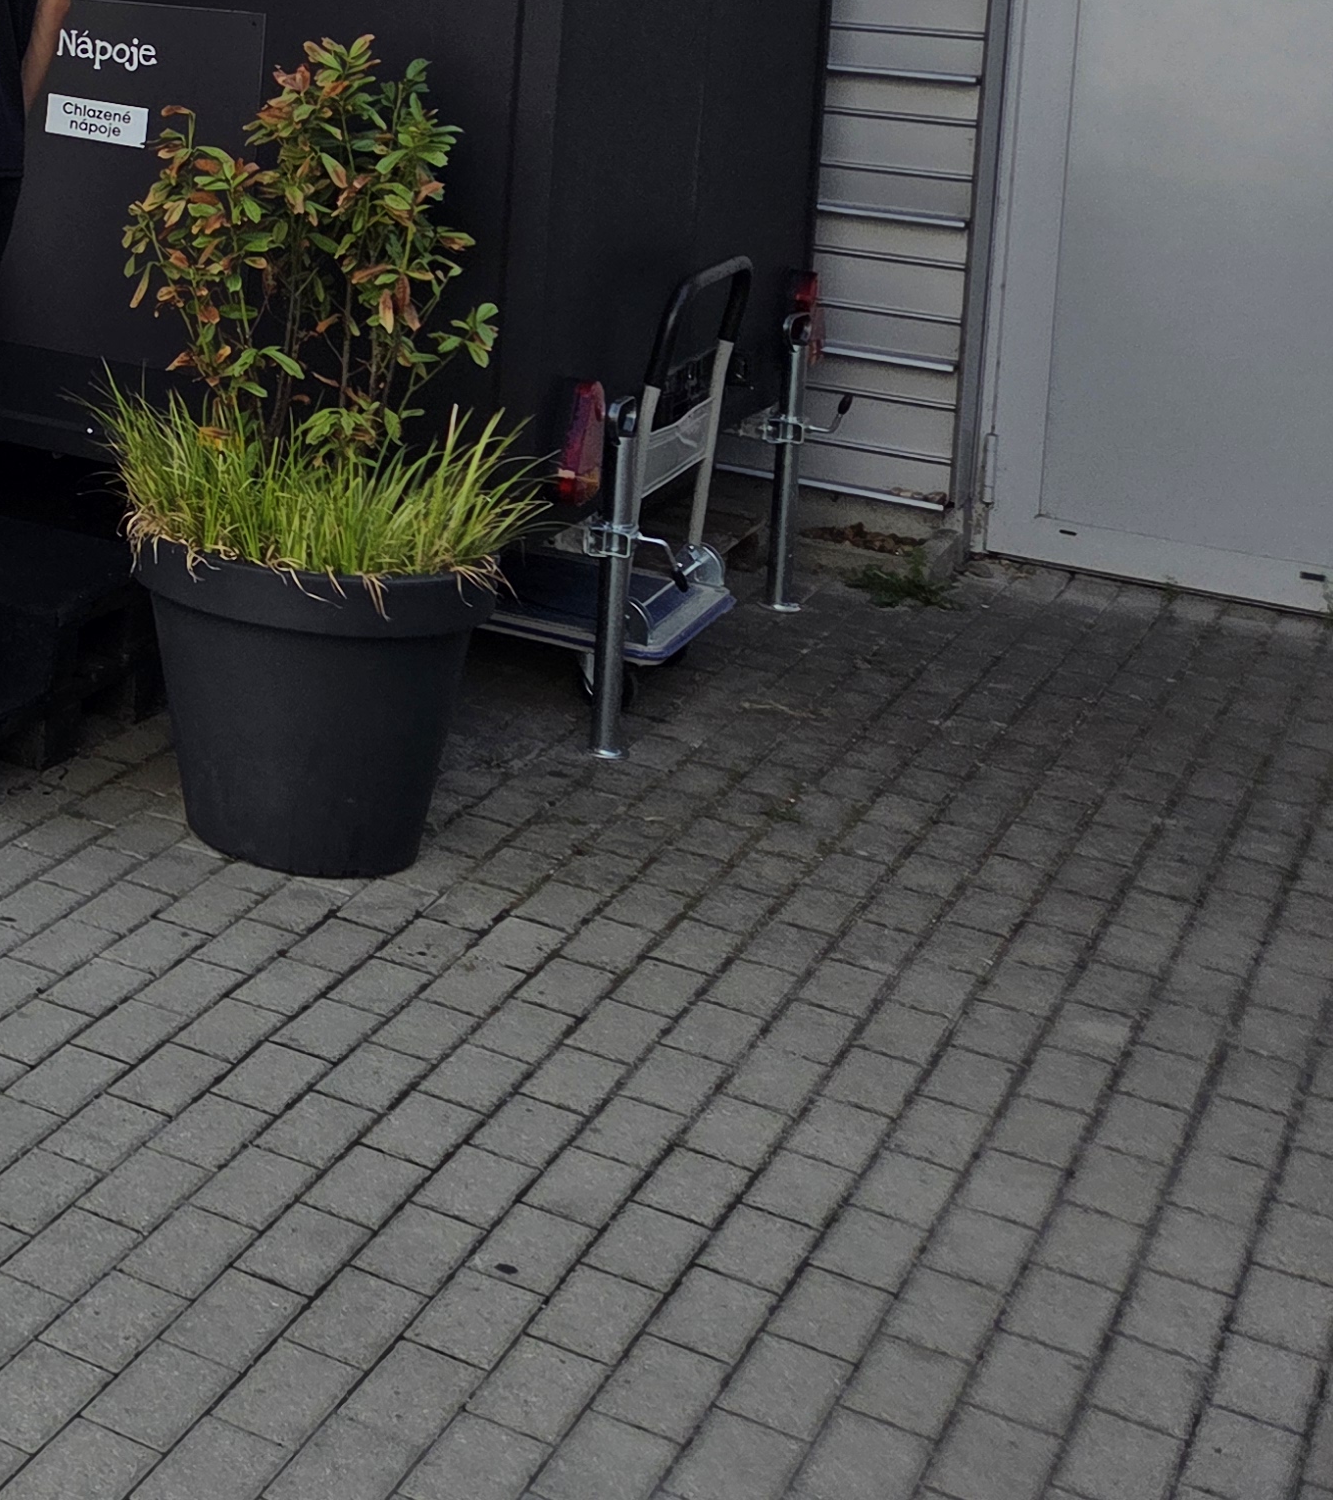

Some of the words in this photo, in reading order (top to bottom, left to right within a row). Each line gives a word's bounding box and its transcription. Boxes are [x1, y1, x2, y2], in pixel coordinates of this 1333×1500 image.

[56, 28, 158, 71] Nápoje
[62, 101, 132, 125] Chlazené
[69, 118, 121, 138] nápoje
